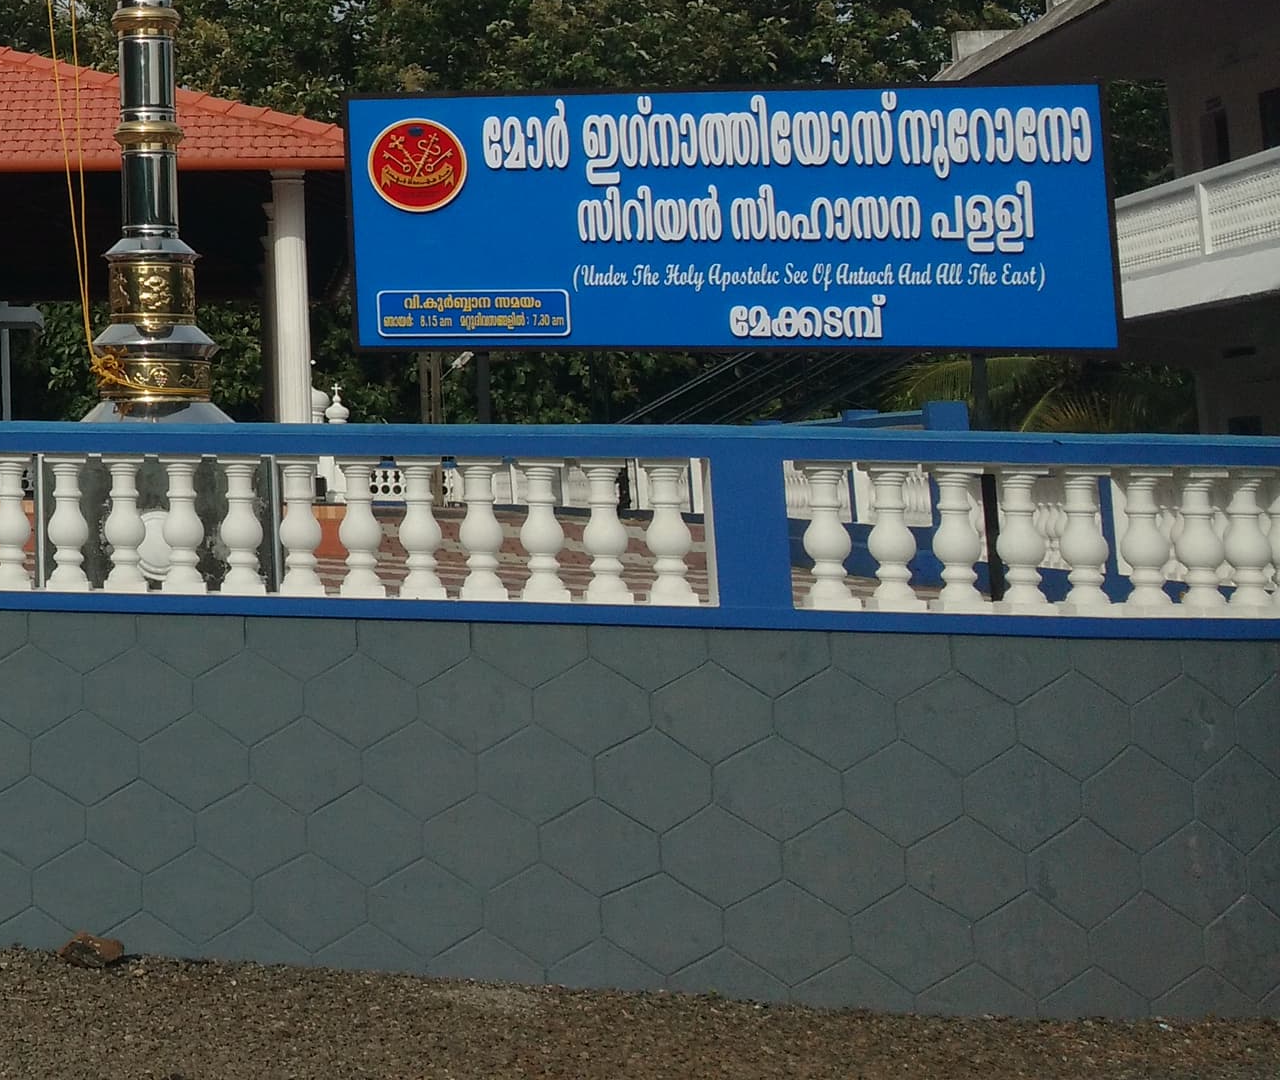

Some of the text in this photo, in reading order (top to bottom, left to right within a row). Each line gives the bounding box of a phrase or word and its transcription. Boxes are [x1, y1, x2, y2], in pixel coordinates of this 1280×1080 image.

[482, 99, 570, 169] മോർ
[577, 185, 722, 242] സിറിയൻ
[730, 184, 921, 240] സിംഹാസന
[573, 262, 1045, 292] (Under The Holy Apostolic See Of Antioch And All The East)
[494, 296, 542, 309] സമയം
[729, 294, 886, 338] മേക്കടമ്പ്
[439, 317, 453, 327] am
[551, 316, 565, 327] am
